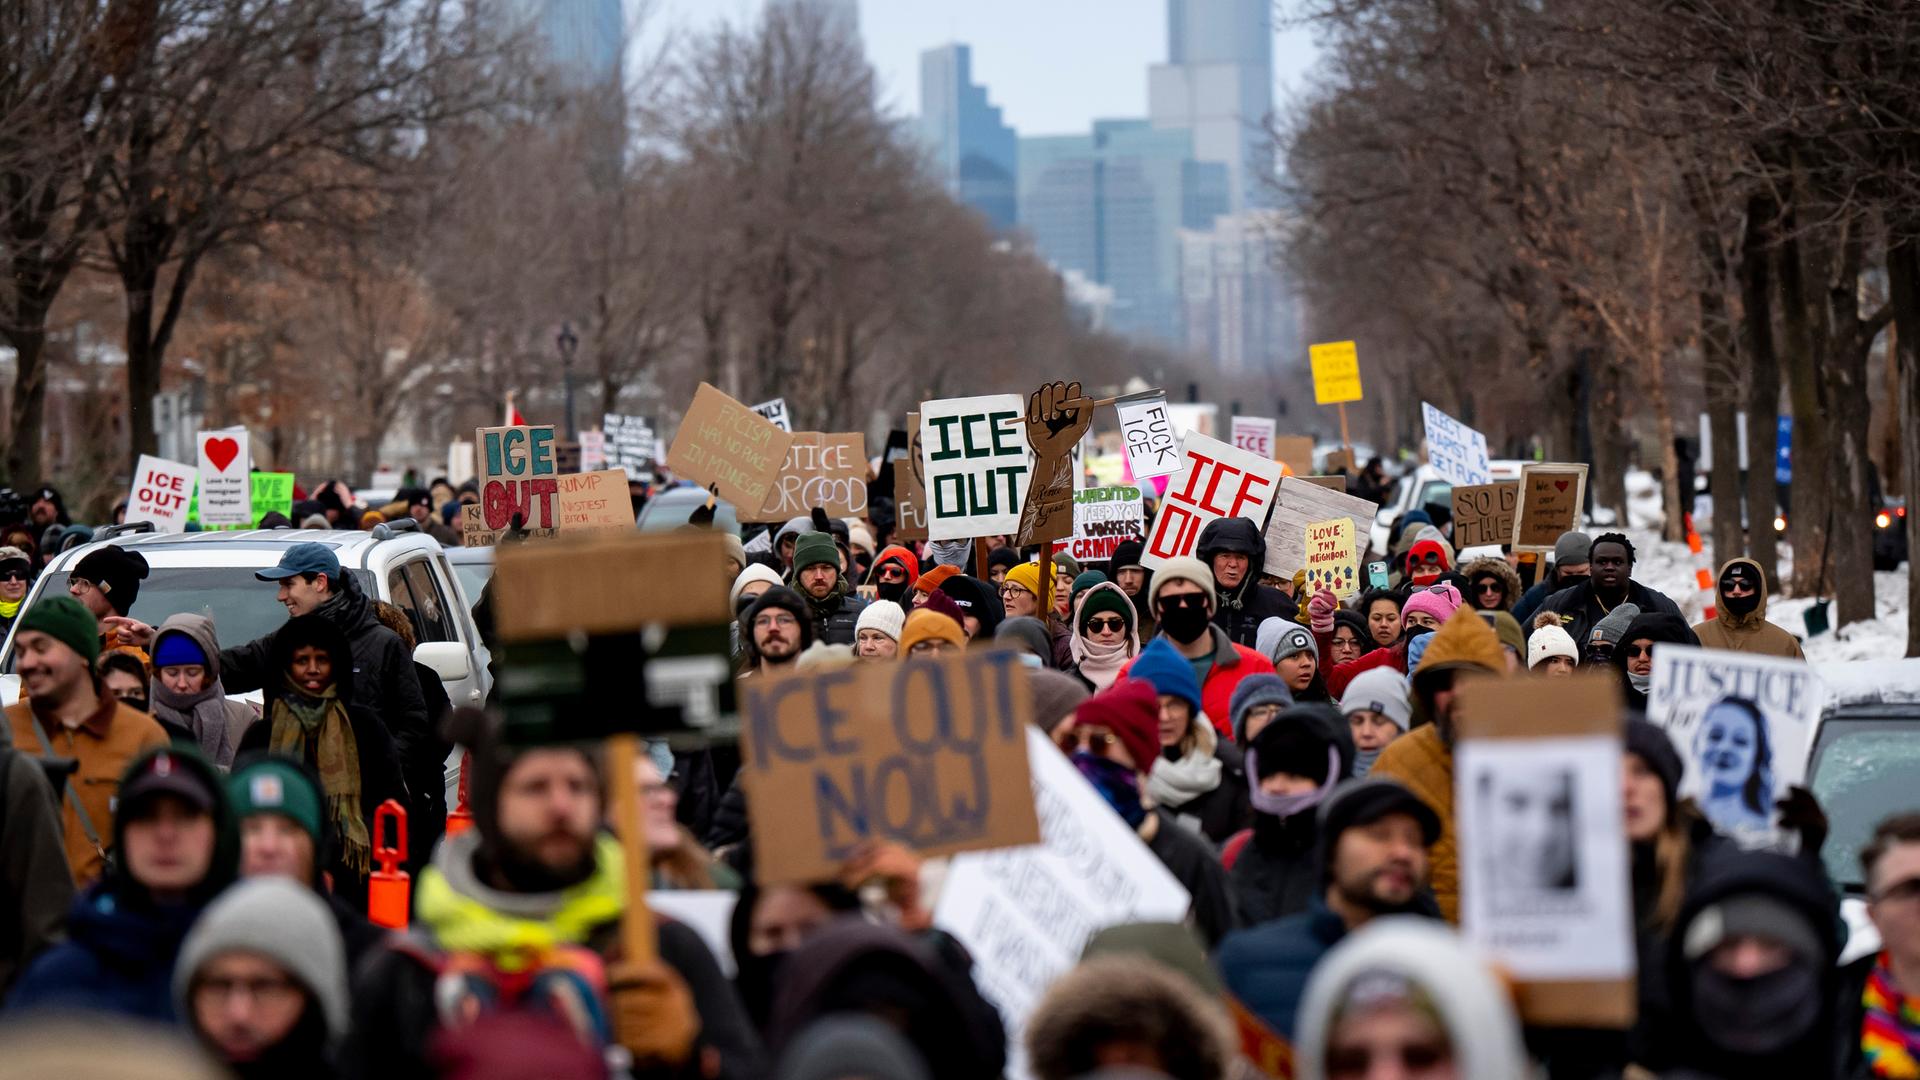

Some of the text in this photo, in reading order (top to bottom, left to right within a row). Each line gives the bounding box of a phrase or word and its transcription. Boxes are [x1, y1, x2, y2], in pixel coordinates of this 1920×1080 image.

[485, 428, 554, 476] ICE
[929, 411, 1023, 461] ICE
[1124, 419, 1152, 458] ICE
[1146, 406, 1177, 466] FUCK
[1236, 435, 1267, 453] ICE
[138, 488, 187, 510] OUT
[147, 469, 185, 492] ICE
[933, 465, 1028, 519] OUT
[139, 505, 151, 513] of
[483, 479, 558, 530] OUT
[1083, 505, 1114, 522] FEED
[1115, 503, 1143, 520] YOU
[1456, 488, 1494, 517] SO
[1083, 519, 1142, 537] WORKERS
[1313, 525, 1340, 540] LOVE
[1318, 541, 1336, 552] THY
[892, 649, 1019, 755] OUT
[1658, 656, 1808, 721] JUSTICE
[748, 669, 862, 771] ICE
[812, 750, 991, 850] NOW
